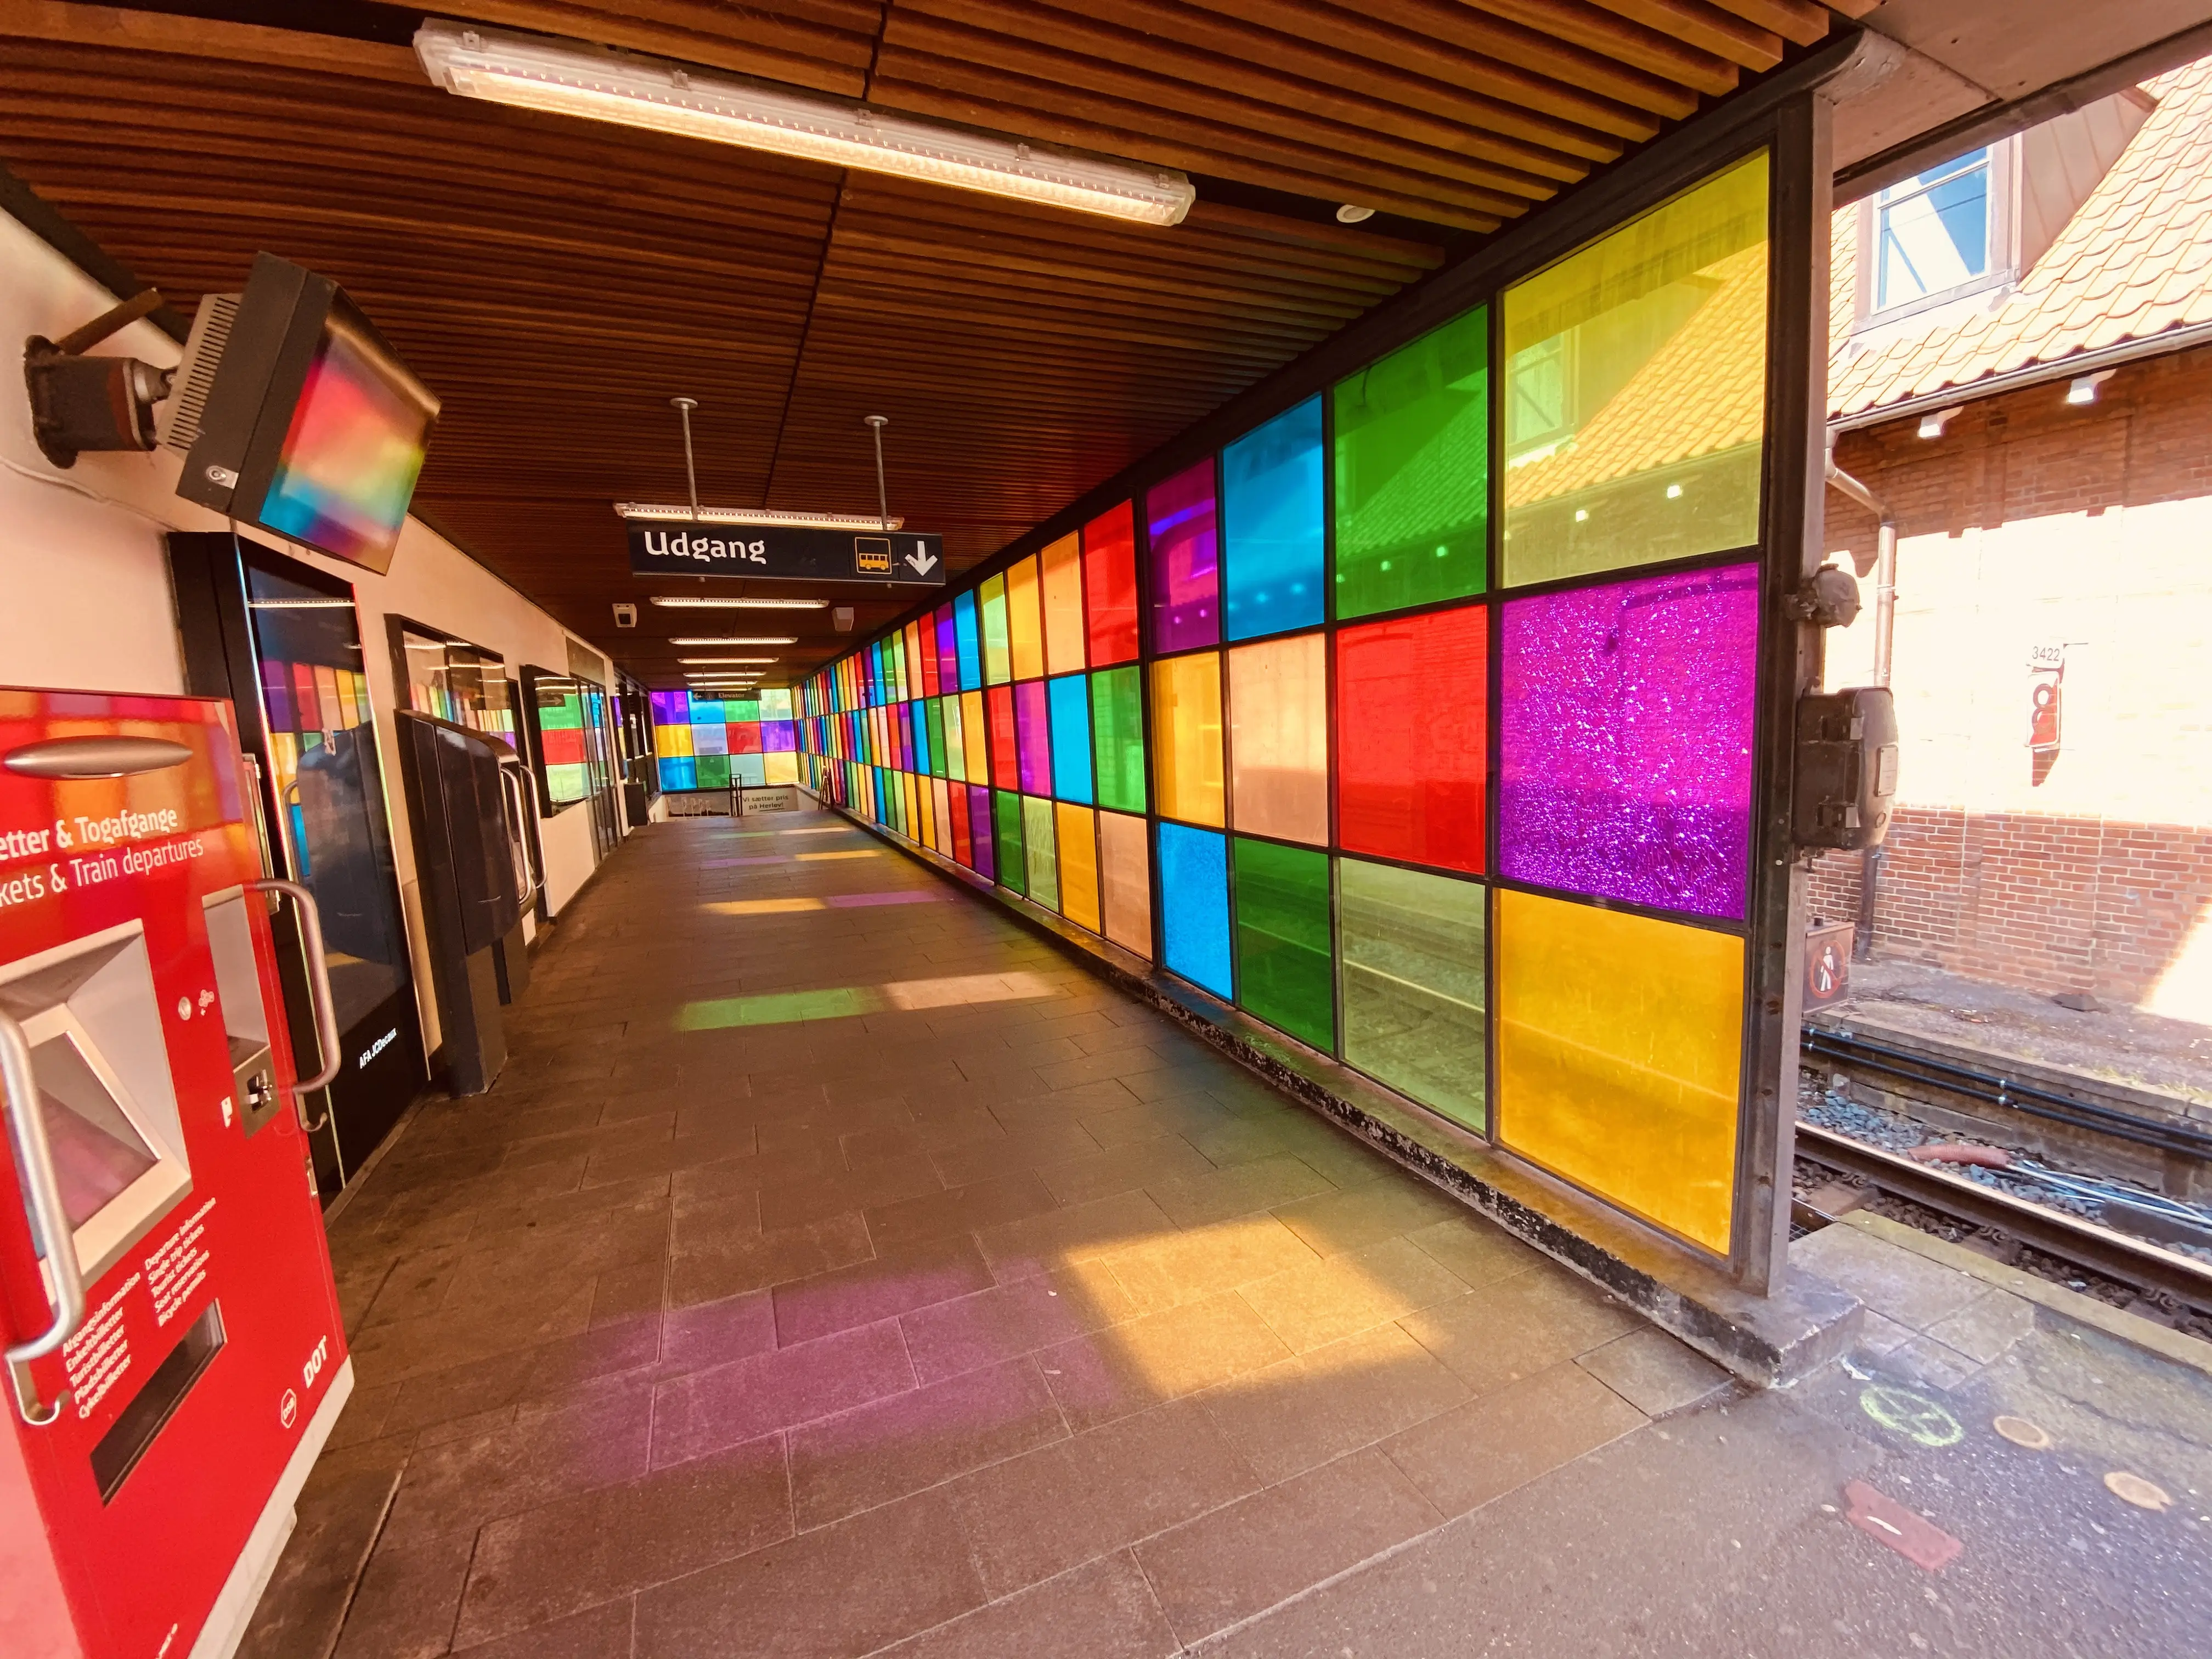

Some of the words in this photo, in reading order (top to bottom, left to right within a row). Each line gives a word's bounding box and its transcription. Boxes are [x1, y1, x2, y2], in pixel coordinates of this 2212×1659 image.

[644, 531, 766, 565] Udgang
[2032, 646, 2060, 662] 3422
[0, 828, 50, 861] etter
[55, 819, 74, 848] &
[75, 808, 178, 844] Togafgange
[0, 873, 45, 907] kets
[50, 863, 67, 893] &
[70, 853, 119, 887] Train
[122, 838, 204, 876] departures
[359, 1049, 373, 1069] AFA
[145, 1232, 179, 1271] Departure
[179, 1197, 216, 1236] information
[63, 1272, 141, 1357] Afgangsinformation
[303, 1334, 327, 1389] DOT
